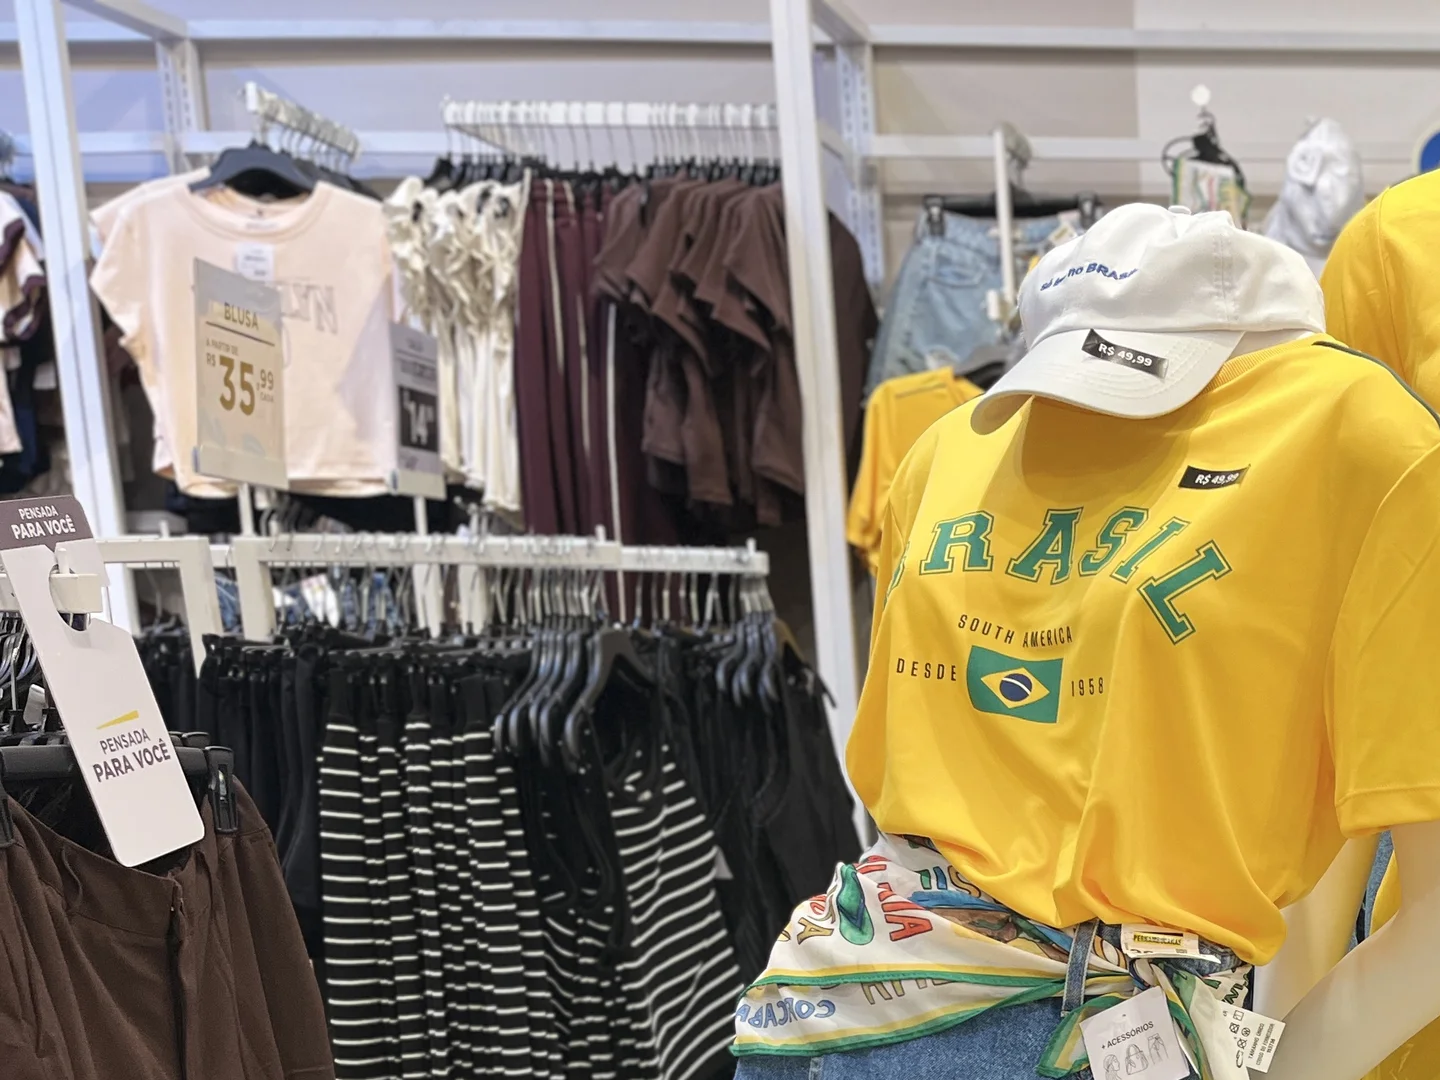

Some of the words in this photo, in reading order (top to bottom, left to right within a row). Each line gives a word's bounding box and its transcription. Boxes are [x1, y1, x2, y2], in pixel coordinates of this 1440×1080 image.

[1068, 266, 1084, 277] no
[224, 302, 259, 330] BLUSA
[206, 352, 216, 367] R$
[1099, 343, 1115, 356] R$
[1118, 350, 1153, 367] 49,99
[1195, 473, 1211, 485] R$
[18, 505, 59, 520] PENSADA
[11, 522, 46, 540] PARA
[44, 514, 76, 535] VOCÊ
[884, 507, 1233, 645] RASIL
[958, 614, 1015, 644] SOUTH
[1022, 625, 1073, 648] AMERICA
[896, 658, 957, 682] DESDE
[1071, 677, 1104, 697] 1958
[99, 728, 151, 754] PENSADA
[92, 755, 135, 783] PARA
[132, 738, 171, 769] VOCÊ
[1107, 1020, 1154, 1048] ACESSÓRIOS
